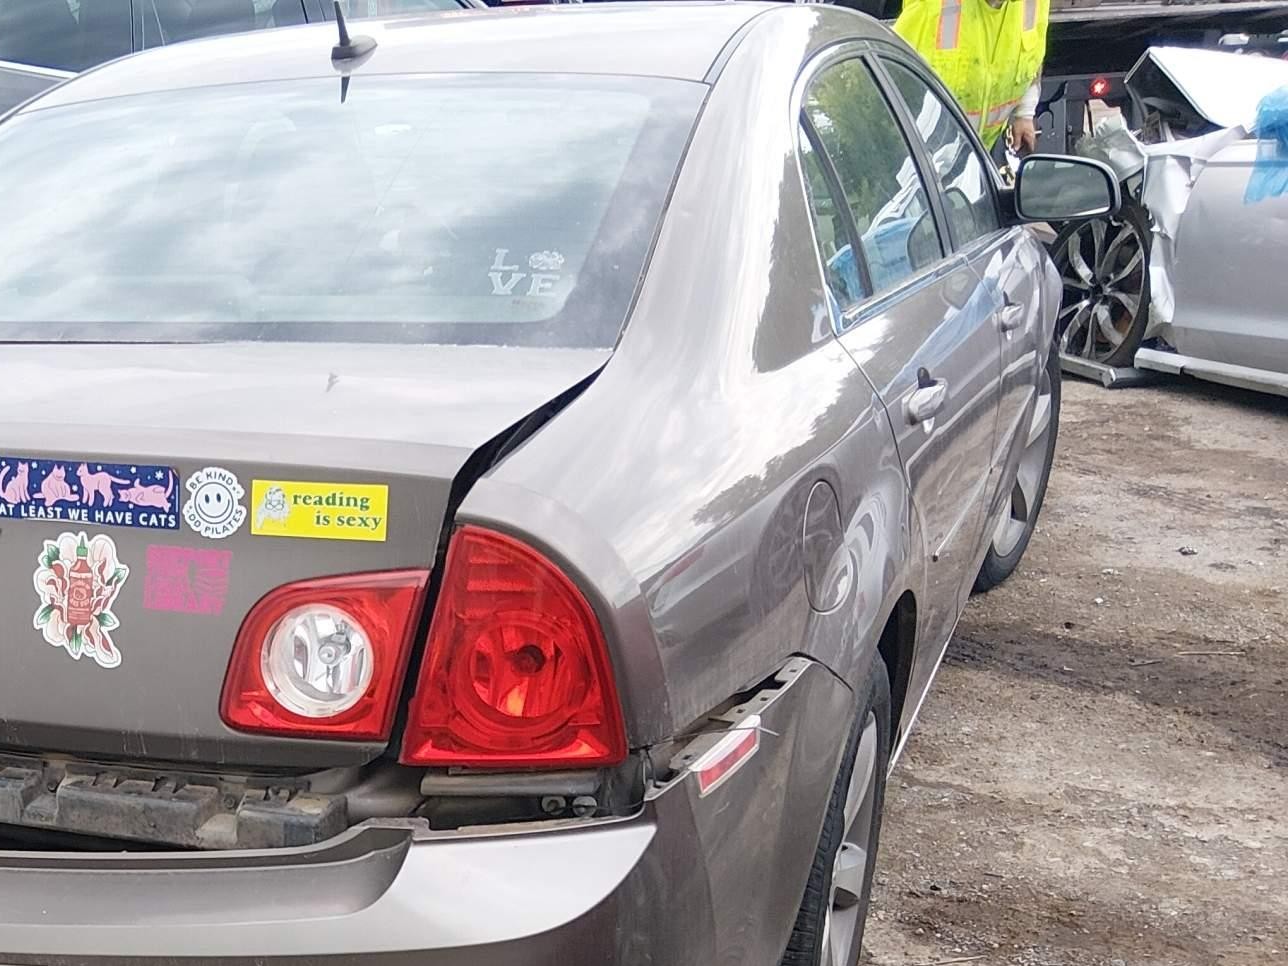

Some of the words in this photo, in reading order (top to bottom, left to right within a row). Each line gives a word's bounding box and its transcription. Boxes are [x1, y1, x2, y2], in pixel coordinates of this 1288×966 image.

[189, 475, 203, 490] BE
[205, 471, 234, 486] KIND
[292, 492, 370, 511] reading
[21, 505, 62, 519] LEAST
[68, 508, 89, 521] WE
[95, 510, 133, 524] HAVE
[139, 513, 176, 528] CATS
[204, 508, 243, 535] PILATES
[315, 510, 330, 525] is
[336, 515, 382, 531] sexy
